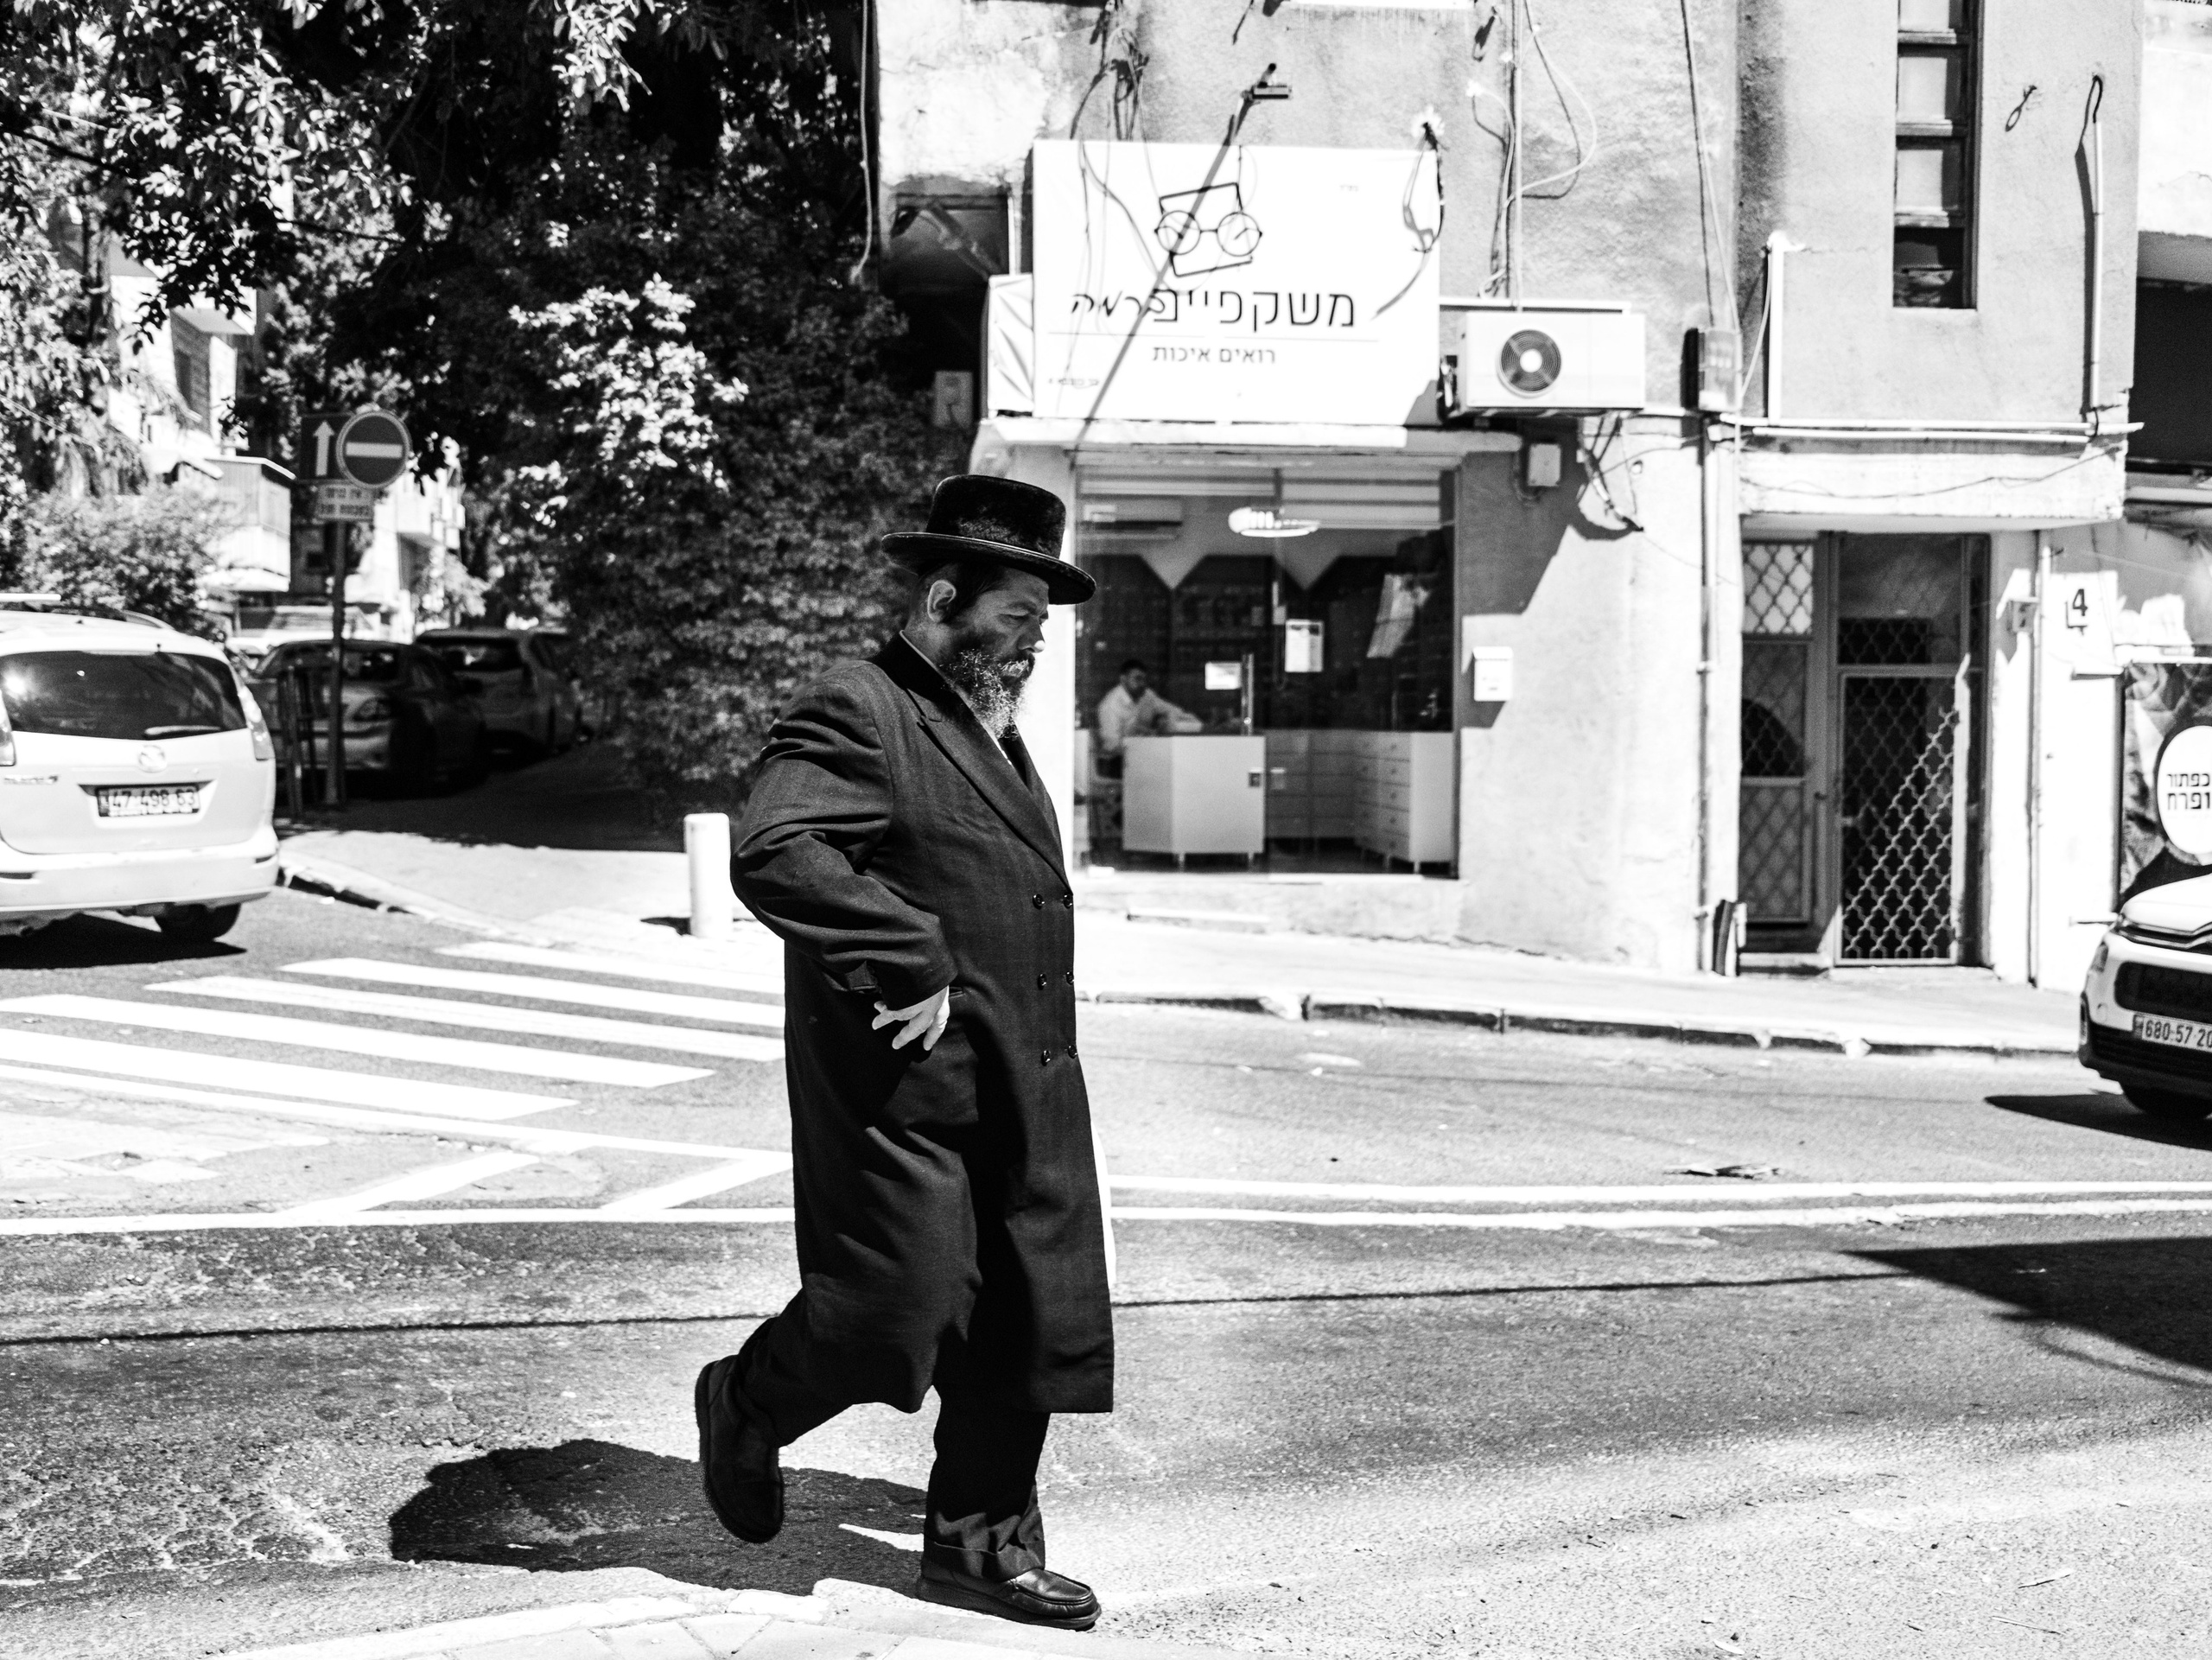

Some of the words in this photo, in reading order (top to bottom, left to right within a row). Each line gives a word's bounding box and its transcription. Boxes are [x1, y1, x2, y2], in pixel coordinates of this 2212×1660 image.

[1152, 346, 1211, 363] איכות
[1219, 347, 1276, 364] רואים
[2072, 588, 2088, 617] 4
[2166, 773, 2211, 788] כפתור
[2166, 791, 2211, 811] ופרח
